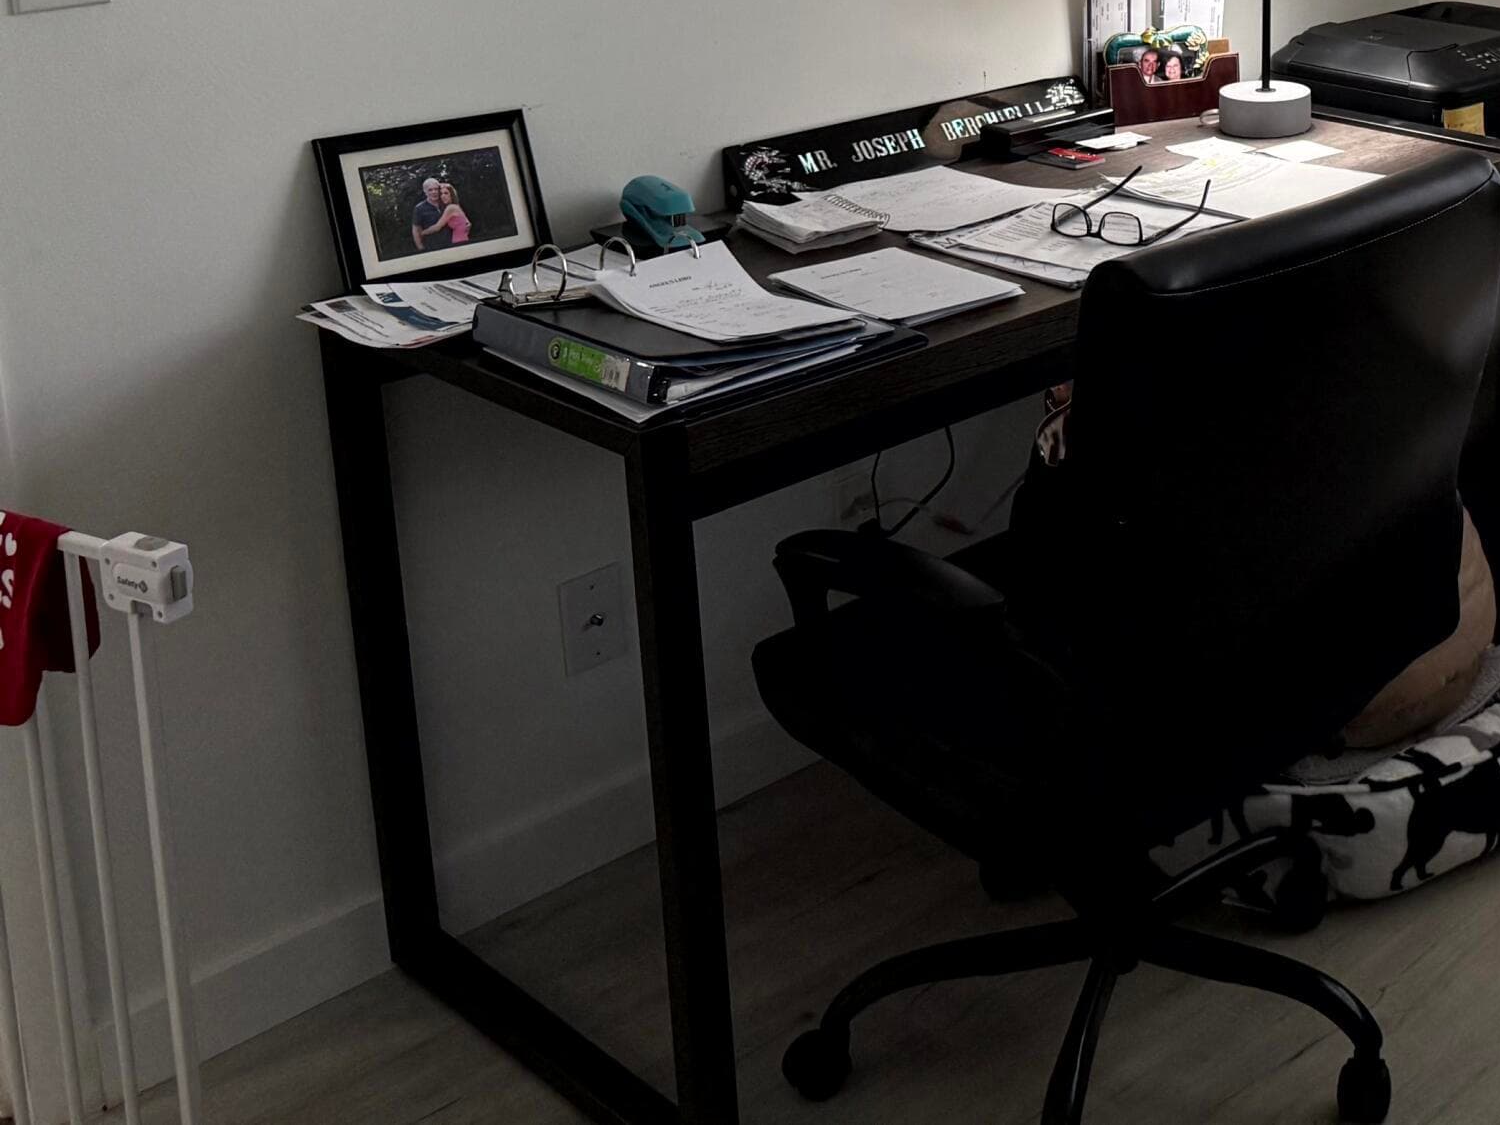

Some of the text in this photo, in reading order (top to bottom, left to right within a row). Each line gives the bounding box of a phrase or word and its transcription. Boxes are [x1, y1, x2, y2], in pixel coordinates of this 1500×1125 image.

[797, 149, 838, 175] MR.
[851, 128, 926, 163] JOSEPH
[116, 575, 138, 590] Safety
